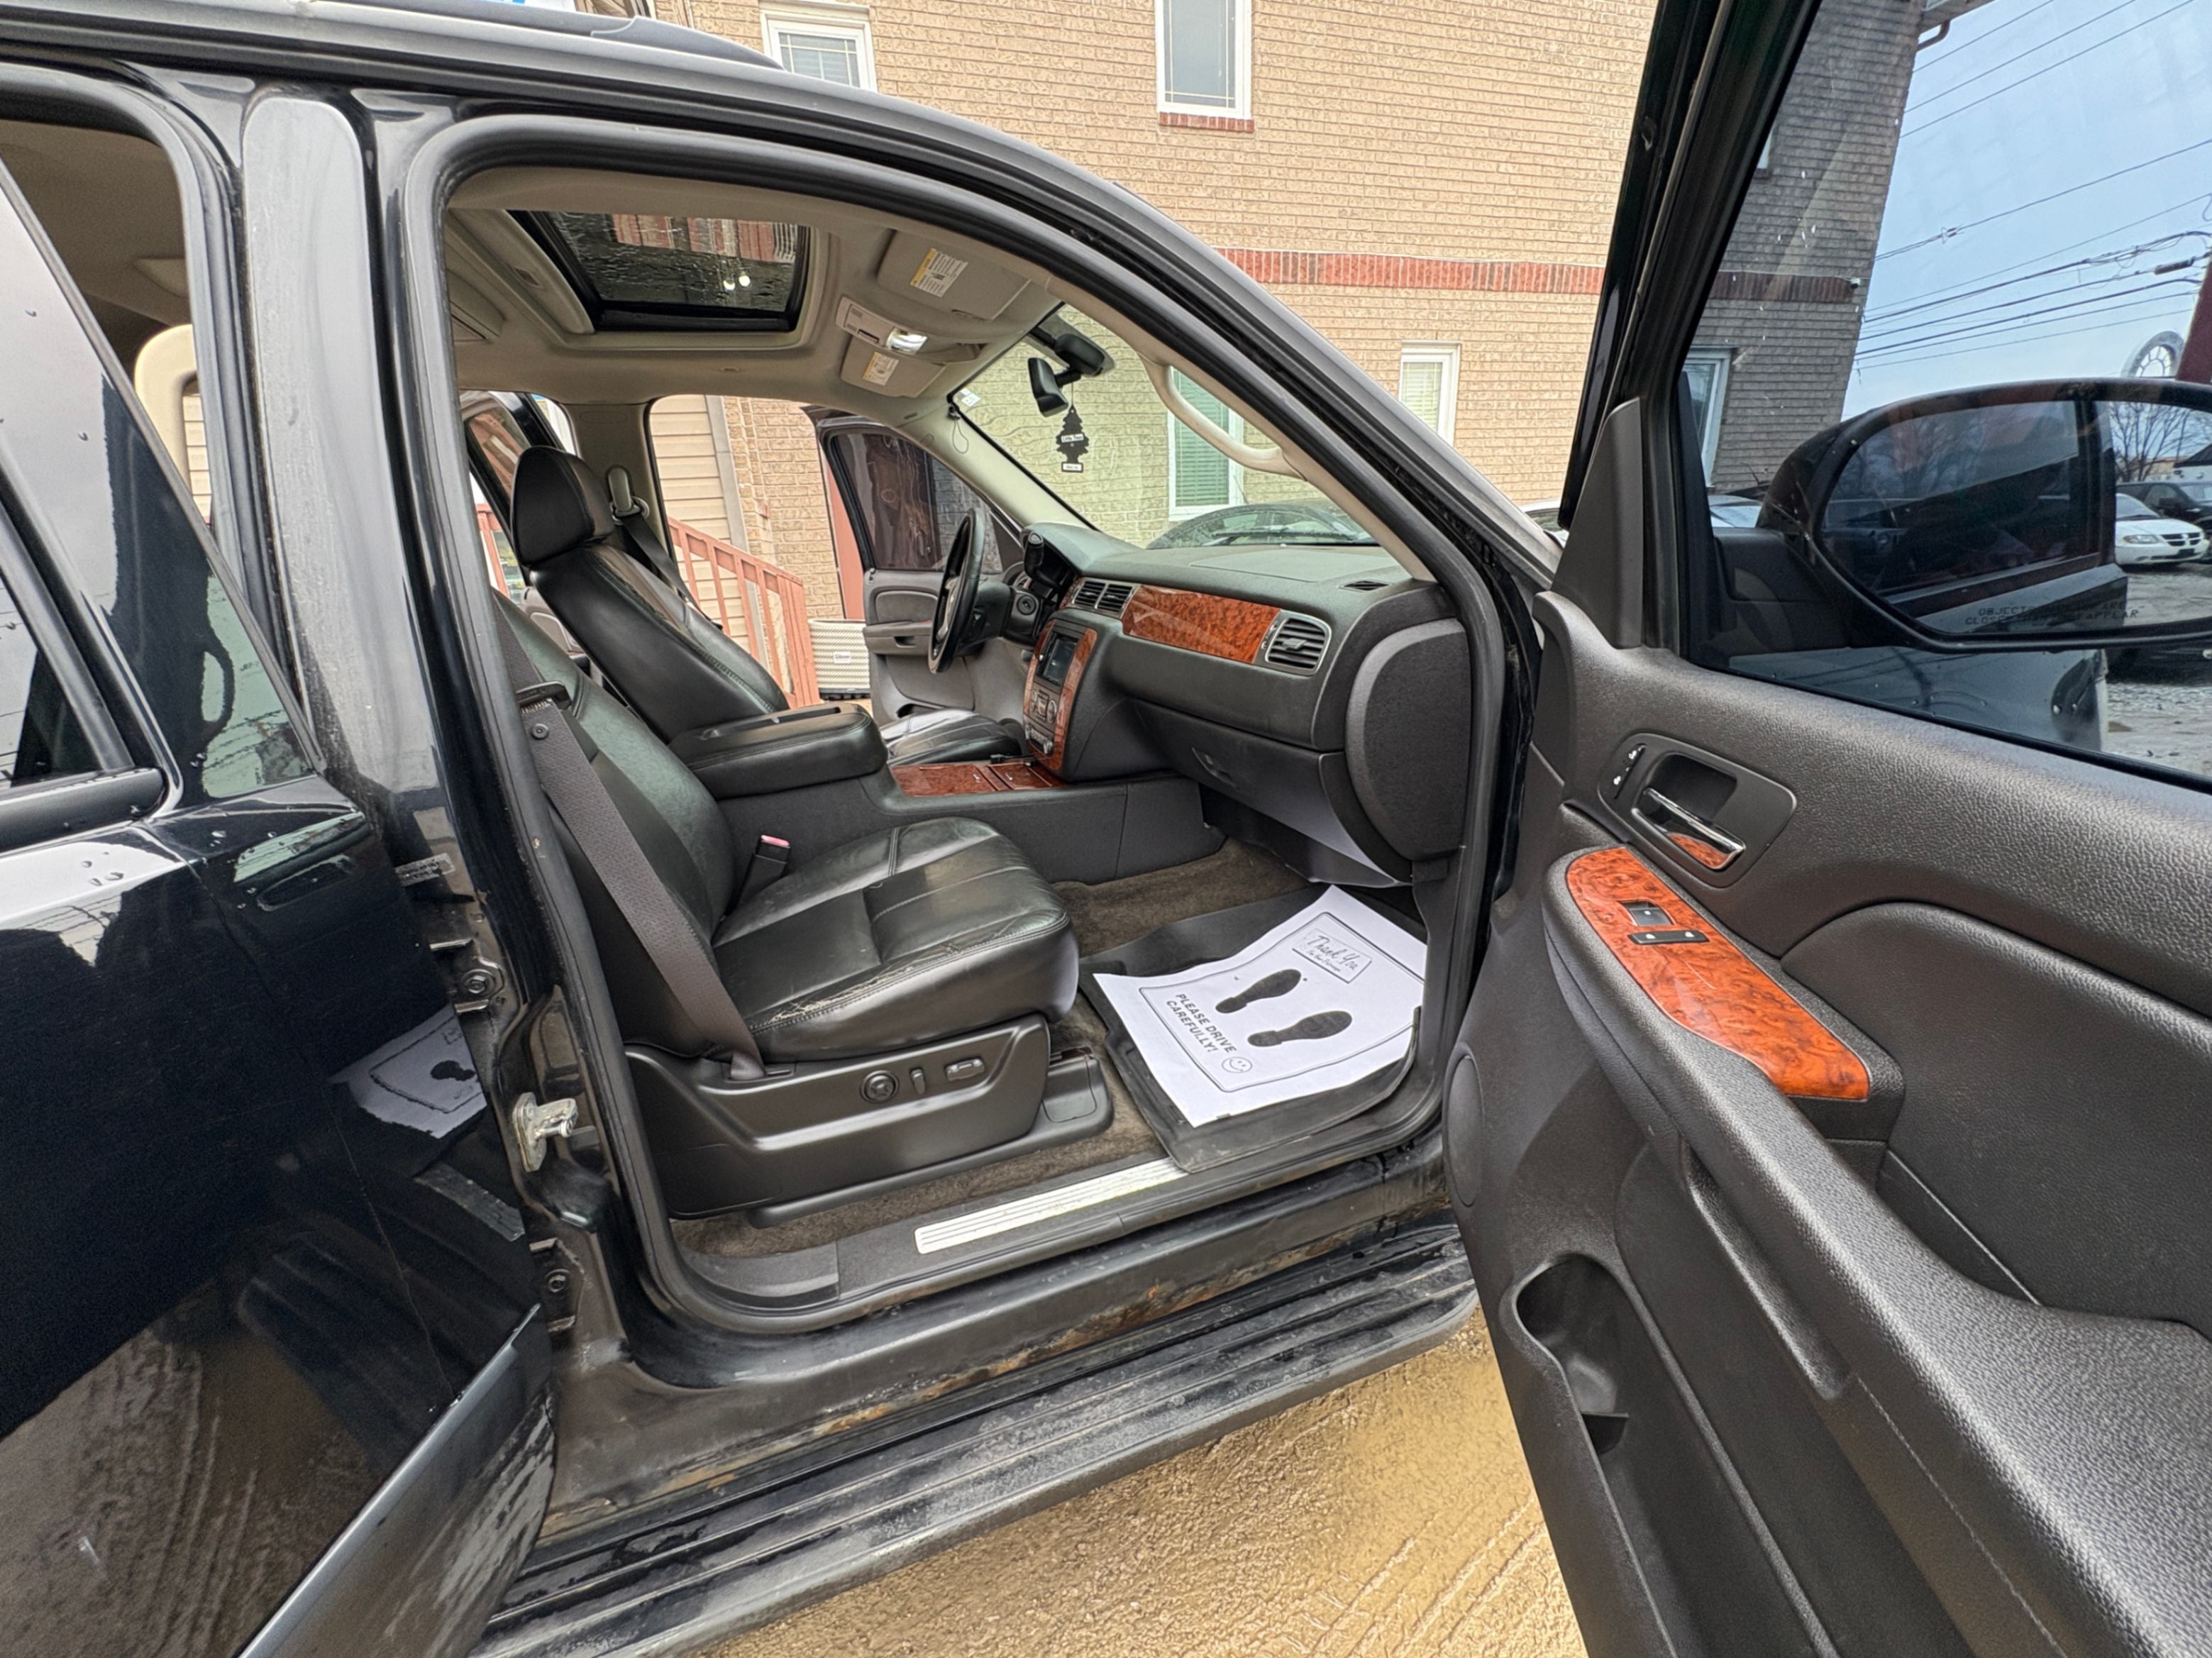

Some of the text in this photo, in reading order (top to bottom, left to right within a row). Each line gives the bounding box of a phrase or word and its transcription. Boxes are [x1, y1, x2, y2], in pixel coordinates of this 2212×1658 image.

[1307, 935, 1348, 959] Thank
[1339, 953, 1361, 971] You
[1166, 1000, 1219, 1052] CAREFULLY!
[1175, 993, 1237, 1053] PLEASE DRIVE
